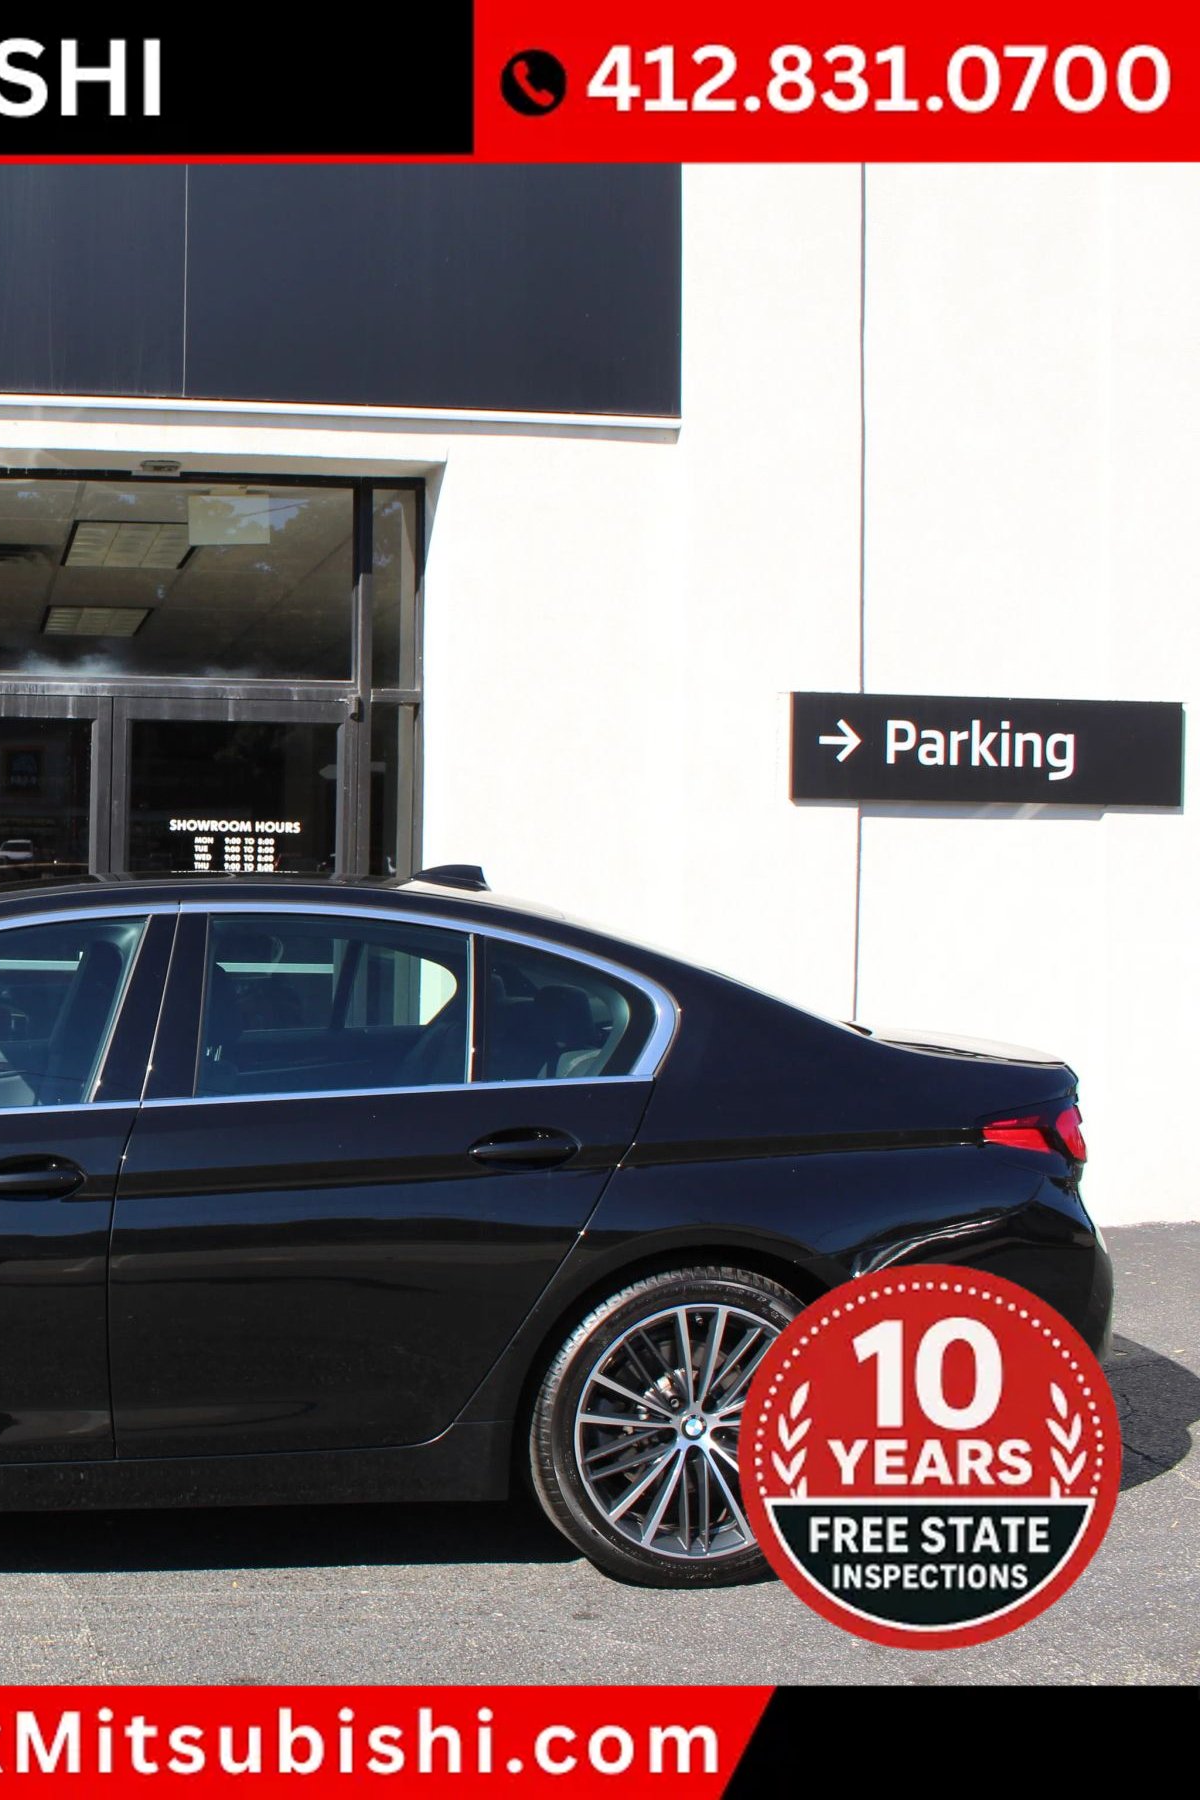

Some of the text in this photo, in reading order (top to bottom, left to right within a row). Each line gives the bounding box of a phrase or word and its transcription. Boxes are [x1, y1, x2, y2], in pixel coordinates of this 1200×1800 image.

[886, 719, 1076, 781] Parking
[169, 819, 301, 834] SHOWROOM HOURS
[194, 836, 214, 844] MON
[224, 837, 241, 845] 9:00
[194, 845, 209, 853] TUE
[224, 845, 241, 853] 9:00
[193, 853, 212, 861] WED
[224, 854, 241, 862] 9:00
[244, 854, 255, 862] TO
[193, 862, 210, 870] THU
[244, 863, 255, 871] TO
